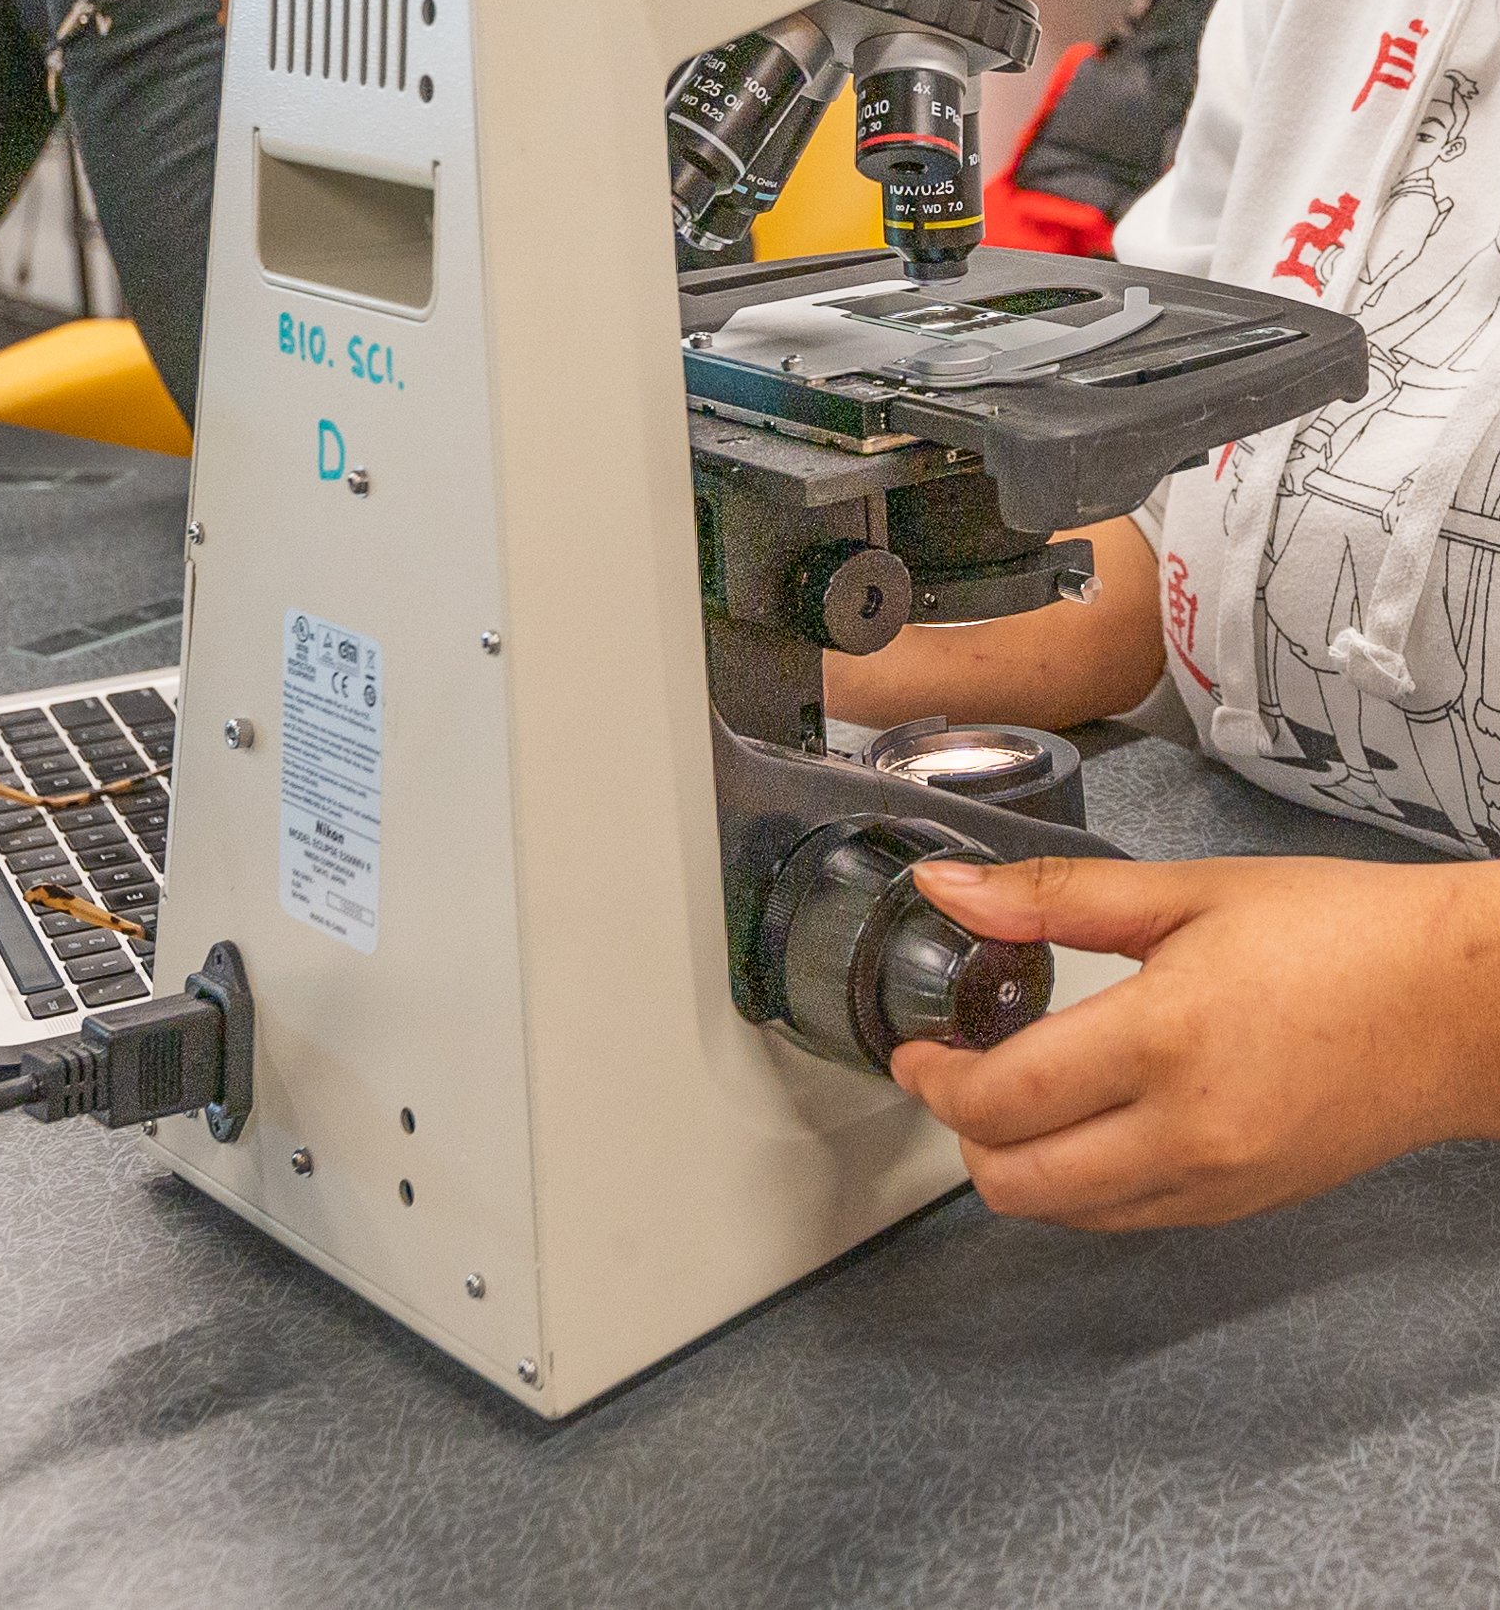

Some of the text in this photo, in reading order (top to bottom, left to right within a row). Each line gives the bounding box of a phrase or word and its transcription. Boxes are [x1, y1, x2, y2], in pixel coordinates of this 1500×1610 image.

[913, 82, 932, 95] 4x
[724, 94, 744, 111] Oil
[701, 103, 725, 122] 0.23
[931, 100, 962, 127] E Pla
[968, 153, 980, 166] 10
[922, 203, 942, 214] WD
[947, 201, 964, 212] 7.0
[278, 312, 405, 390] BIO. SCI.
[318, 418, 345, 480] D
[315, 819, 344, 845] Nikon
